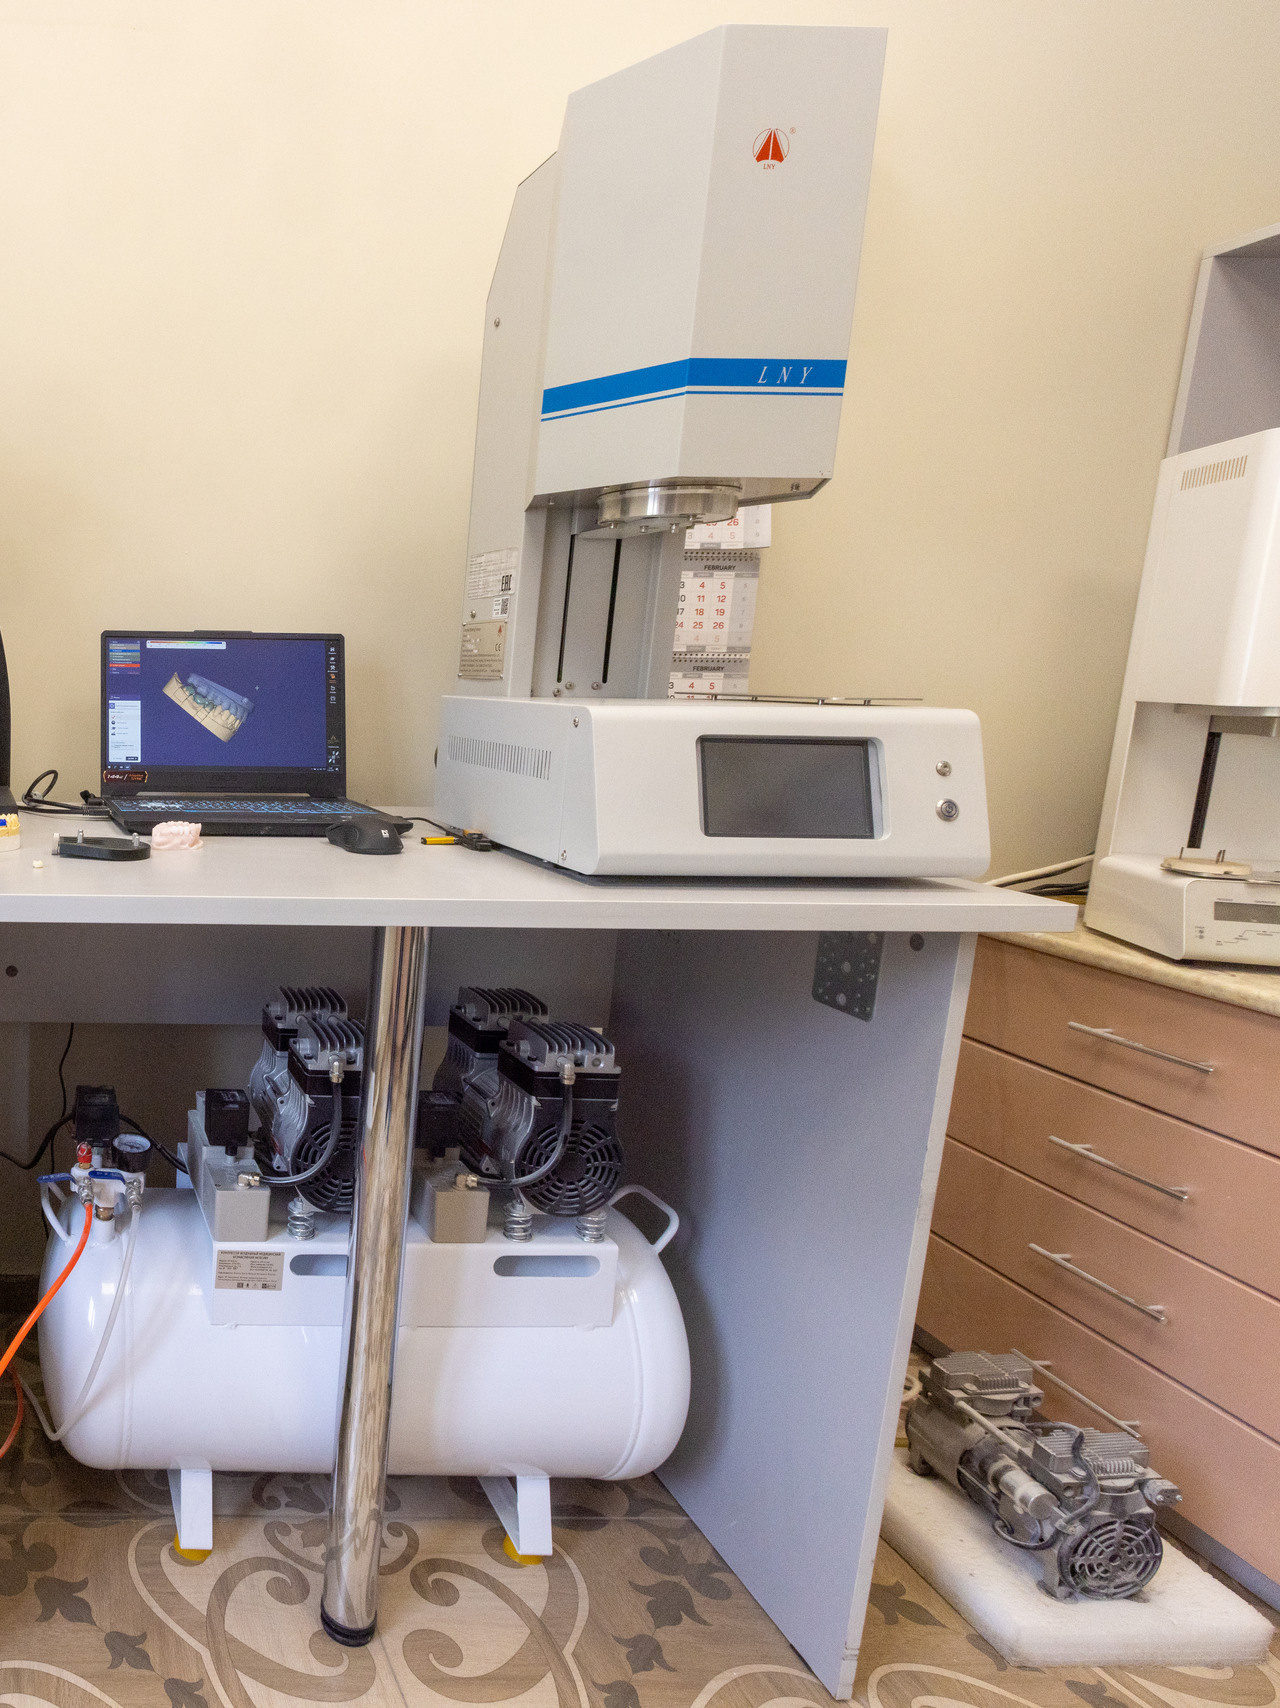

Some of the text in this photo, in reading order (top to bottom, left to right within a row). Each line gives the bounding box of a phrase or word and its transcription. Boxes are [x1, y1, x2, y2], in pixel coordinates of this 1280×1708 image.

[757, 366, 813, 384] LNY
[687, 531, 693, 540] 3
[707, 532, 714, 540] 4
[729, 531, 736, 540] 5
[720, 582, 726, 590] 5
[716, 595, 727, 603] 12
[694, 608, 705, 616] 18
[715, 608, 725, 616] 19
[692, 621, 704, 629] 25
[712, 621, 725, 630] 26
[709, 682, 715, 690] 5
